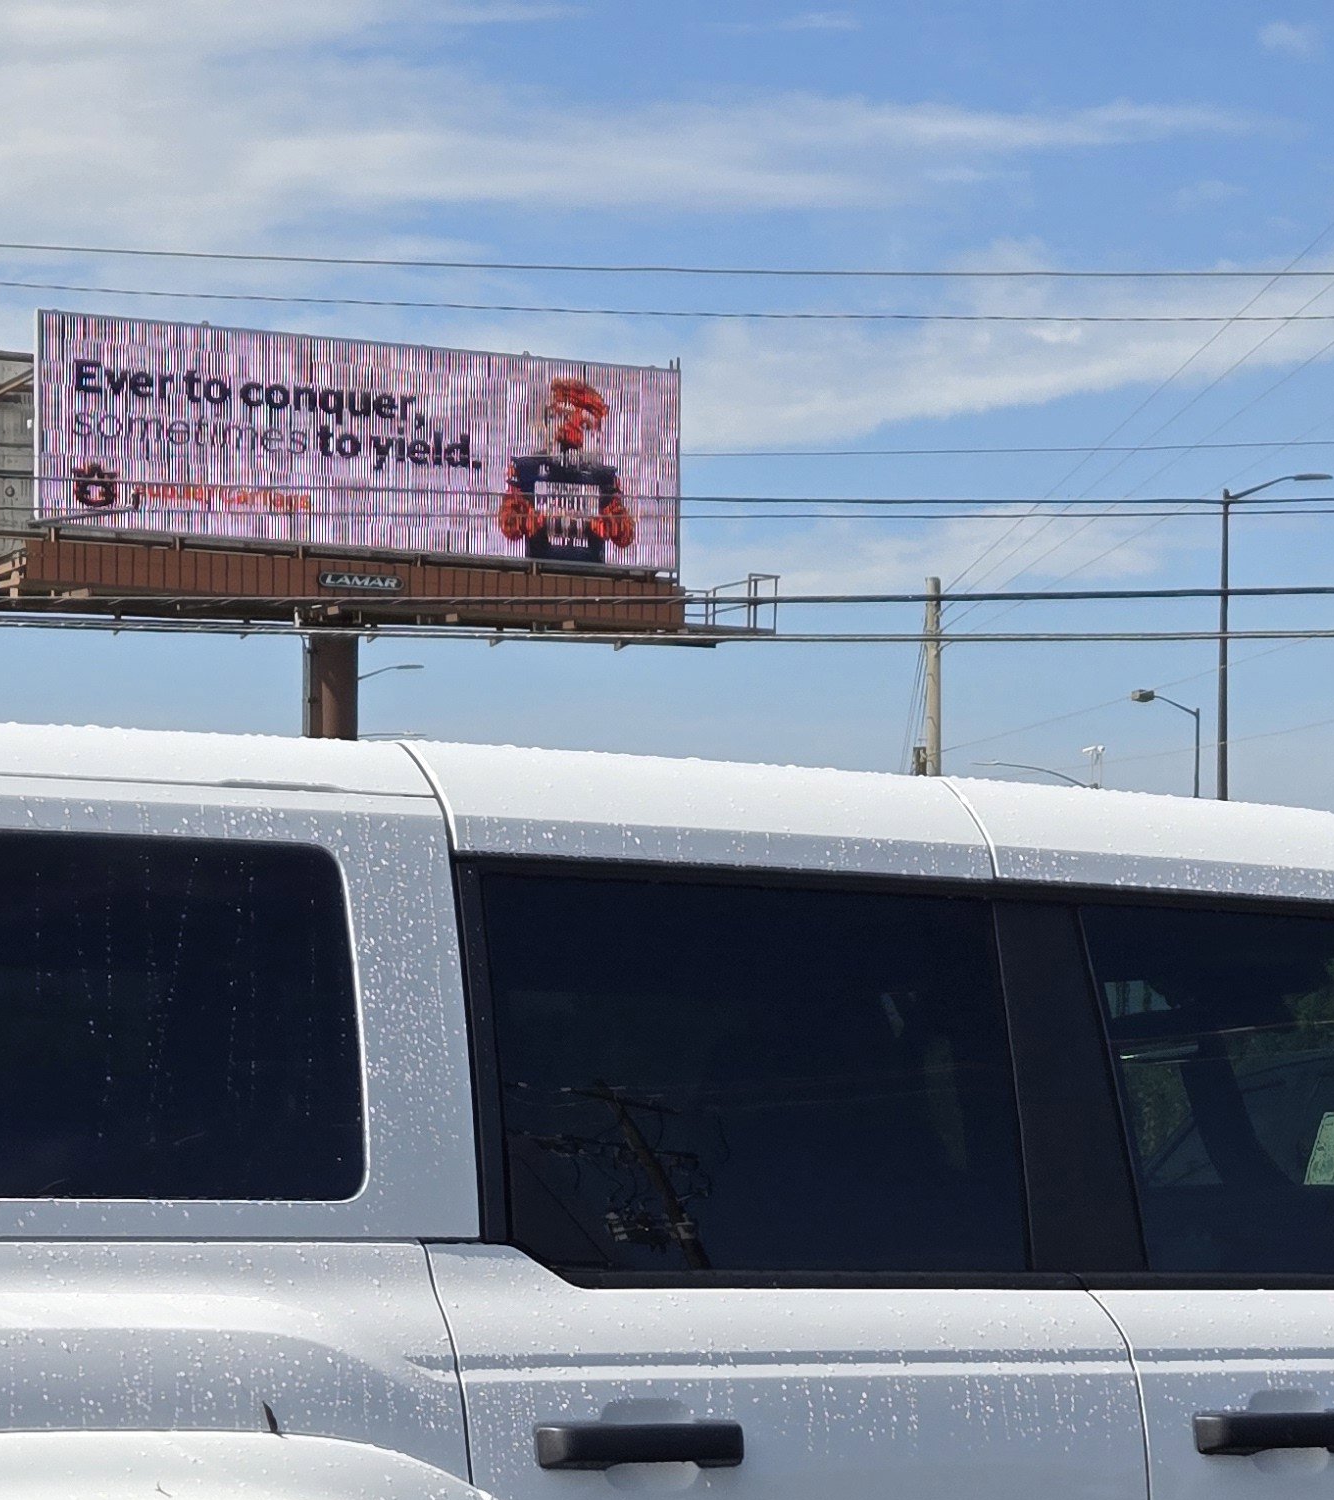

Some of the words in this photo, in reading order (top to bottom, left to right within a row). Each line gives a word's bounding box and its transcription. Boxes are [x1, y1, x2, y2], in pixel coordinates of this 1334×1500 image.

[74, 359, 173, 398] Ever
[184, 369, 231, 404] to
[240, 382, 425, 429] conquer,
[74, 412, 307, 454] sometimes
[318, 425, 362, 458] to
[370, 427, 482, 471] yield.
[326, 574, 398, 588] LAMAR
